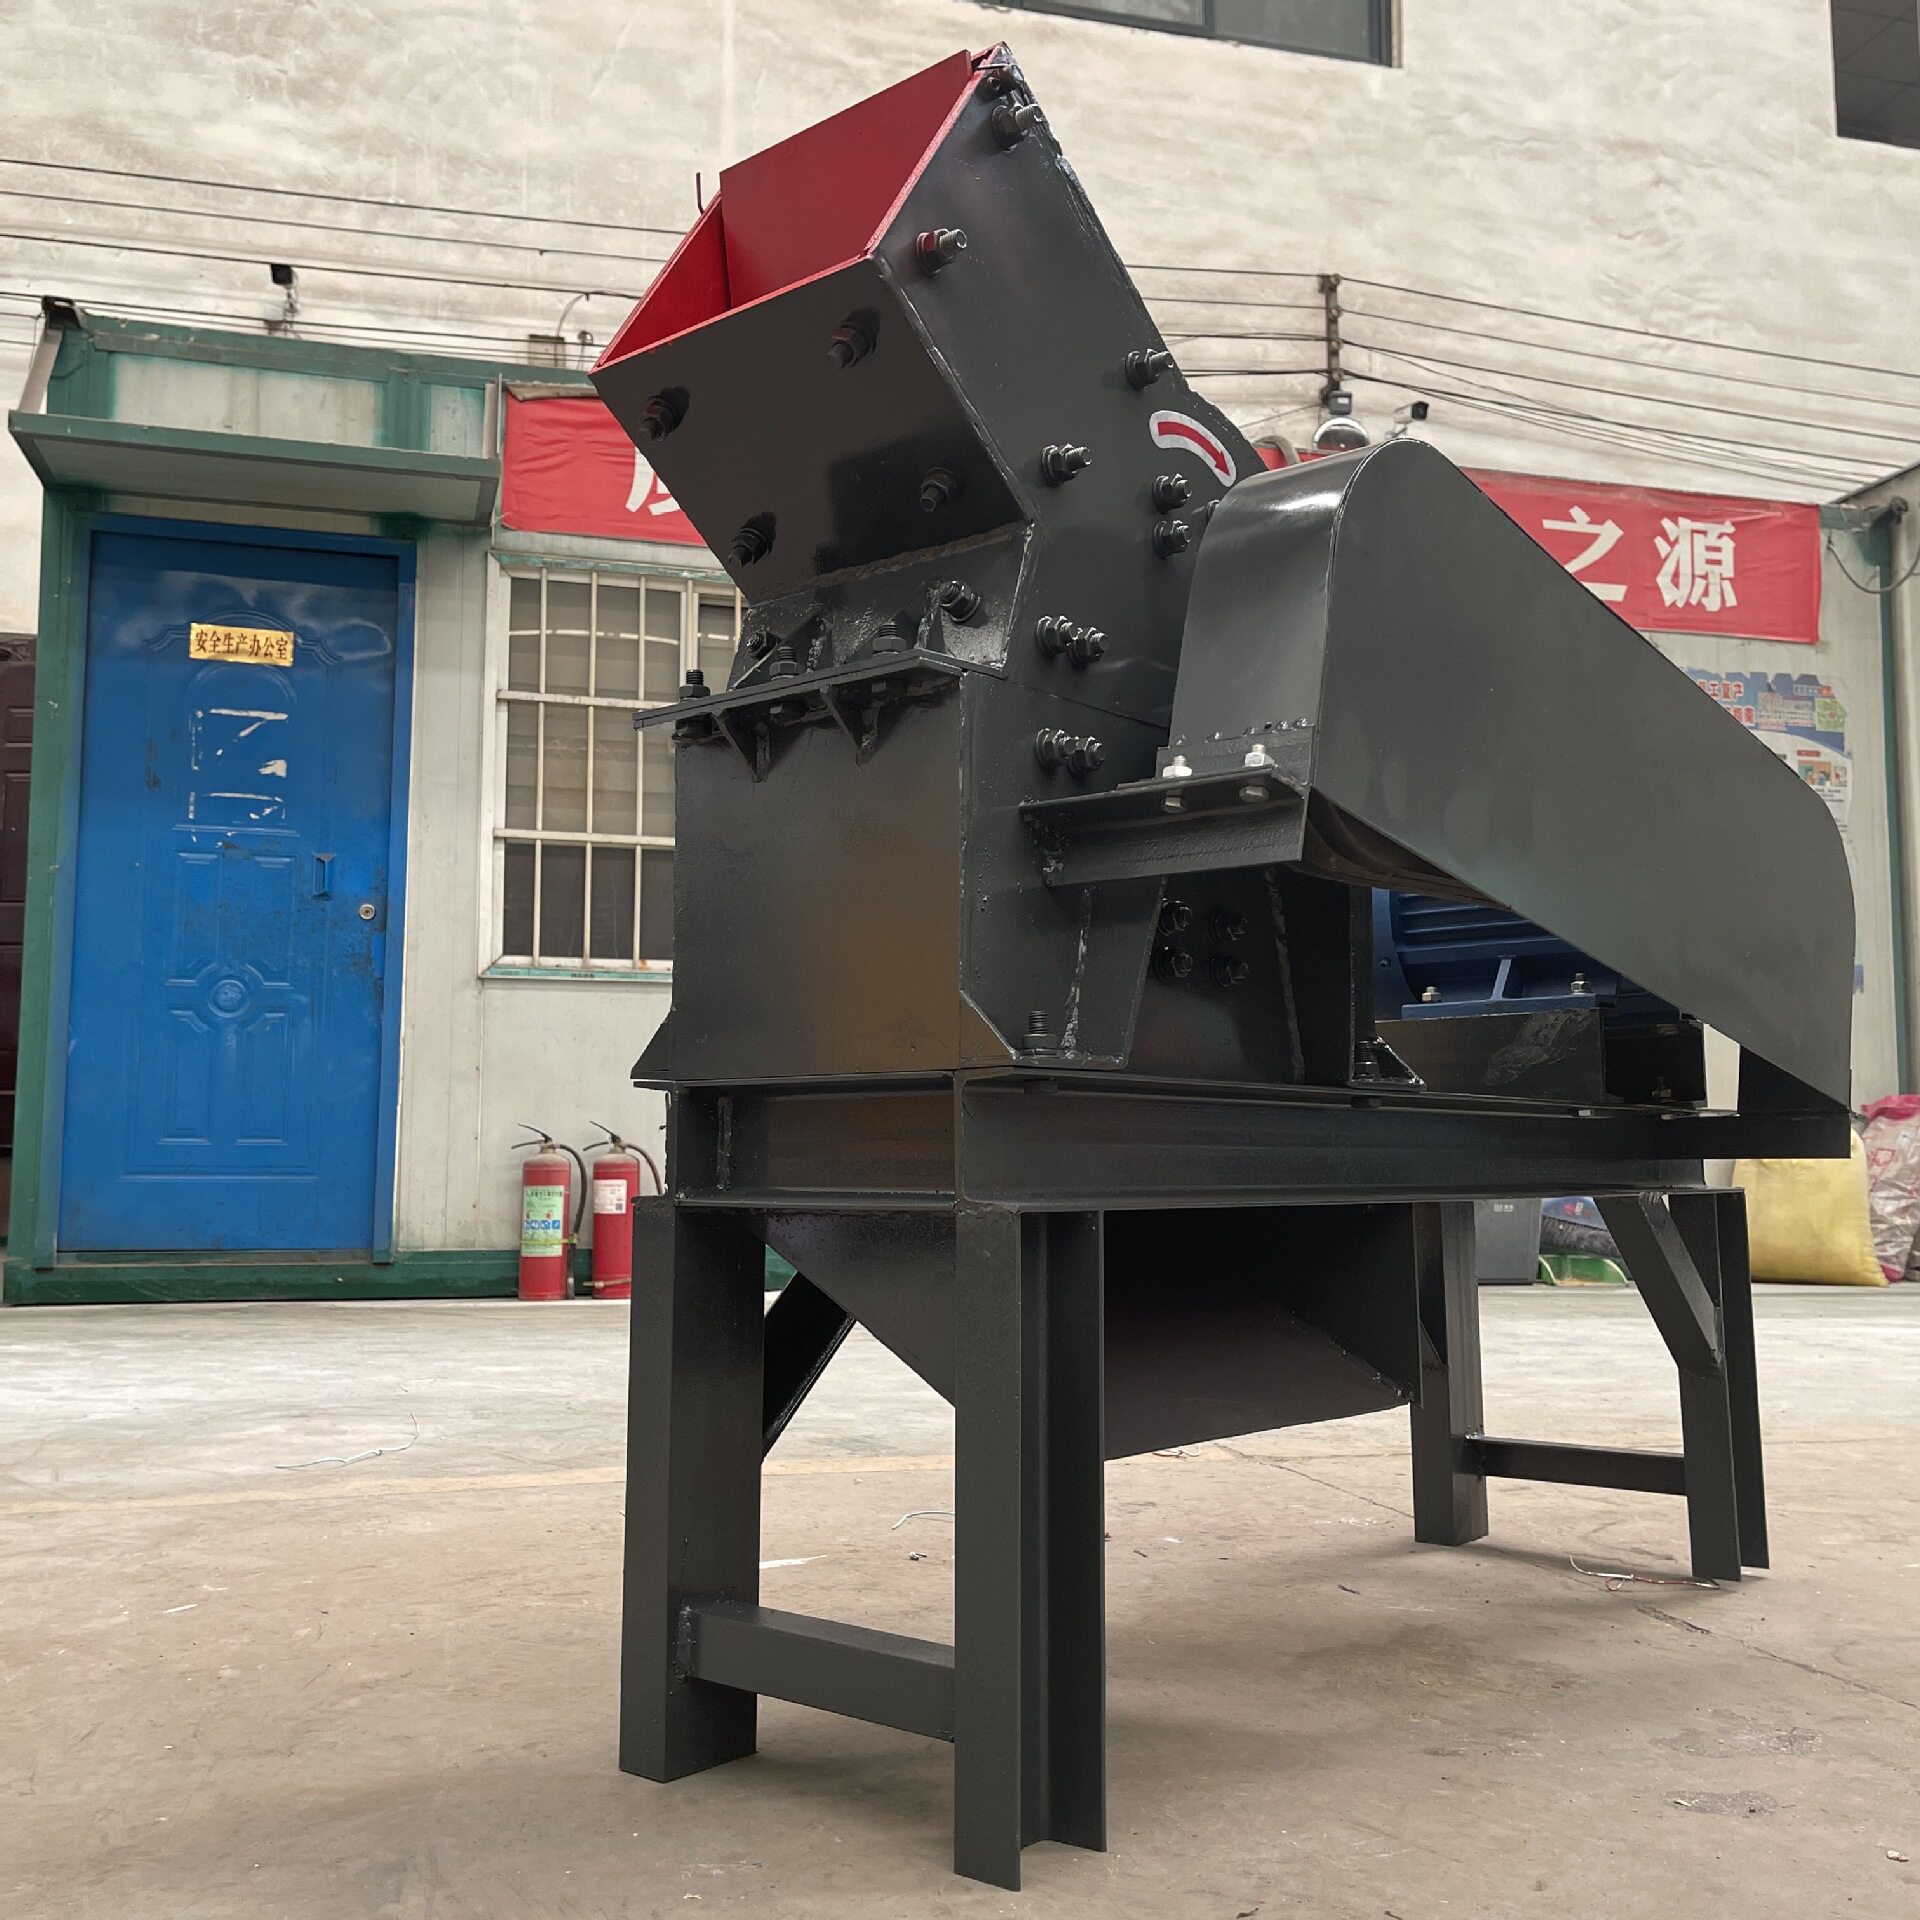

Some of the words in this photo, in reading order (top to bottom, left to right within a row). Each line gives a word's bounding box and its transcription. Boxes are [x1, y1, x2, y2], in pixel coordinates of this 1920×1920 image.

[1542, 505, 1738, 612] 之源
[195, 629, 289, 660] 安全生产办公室
